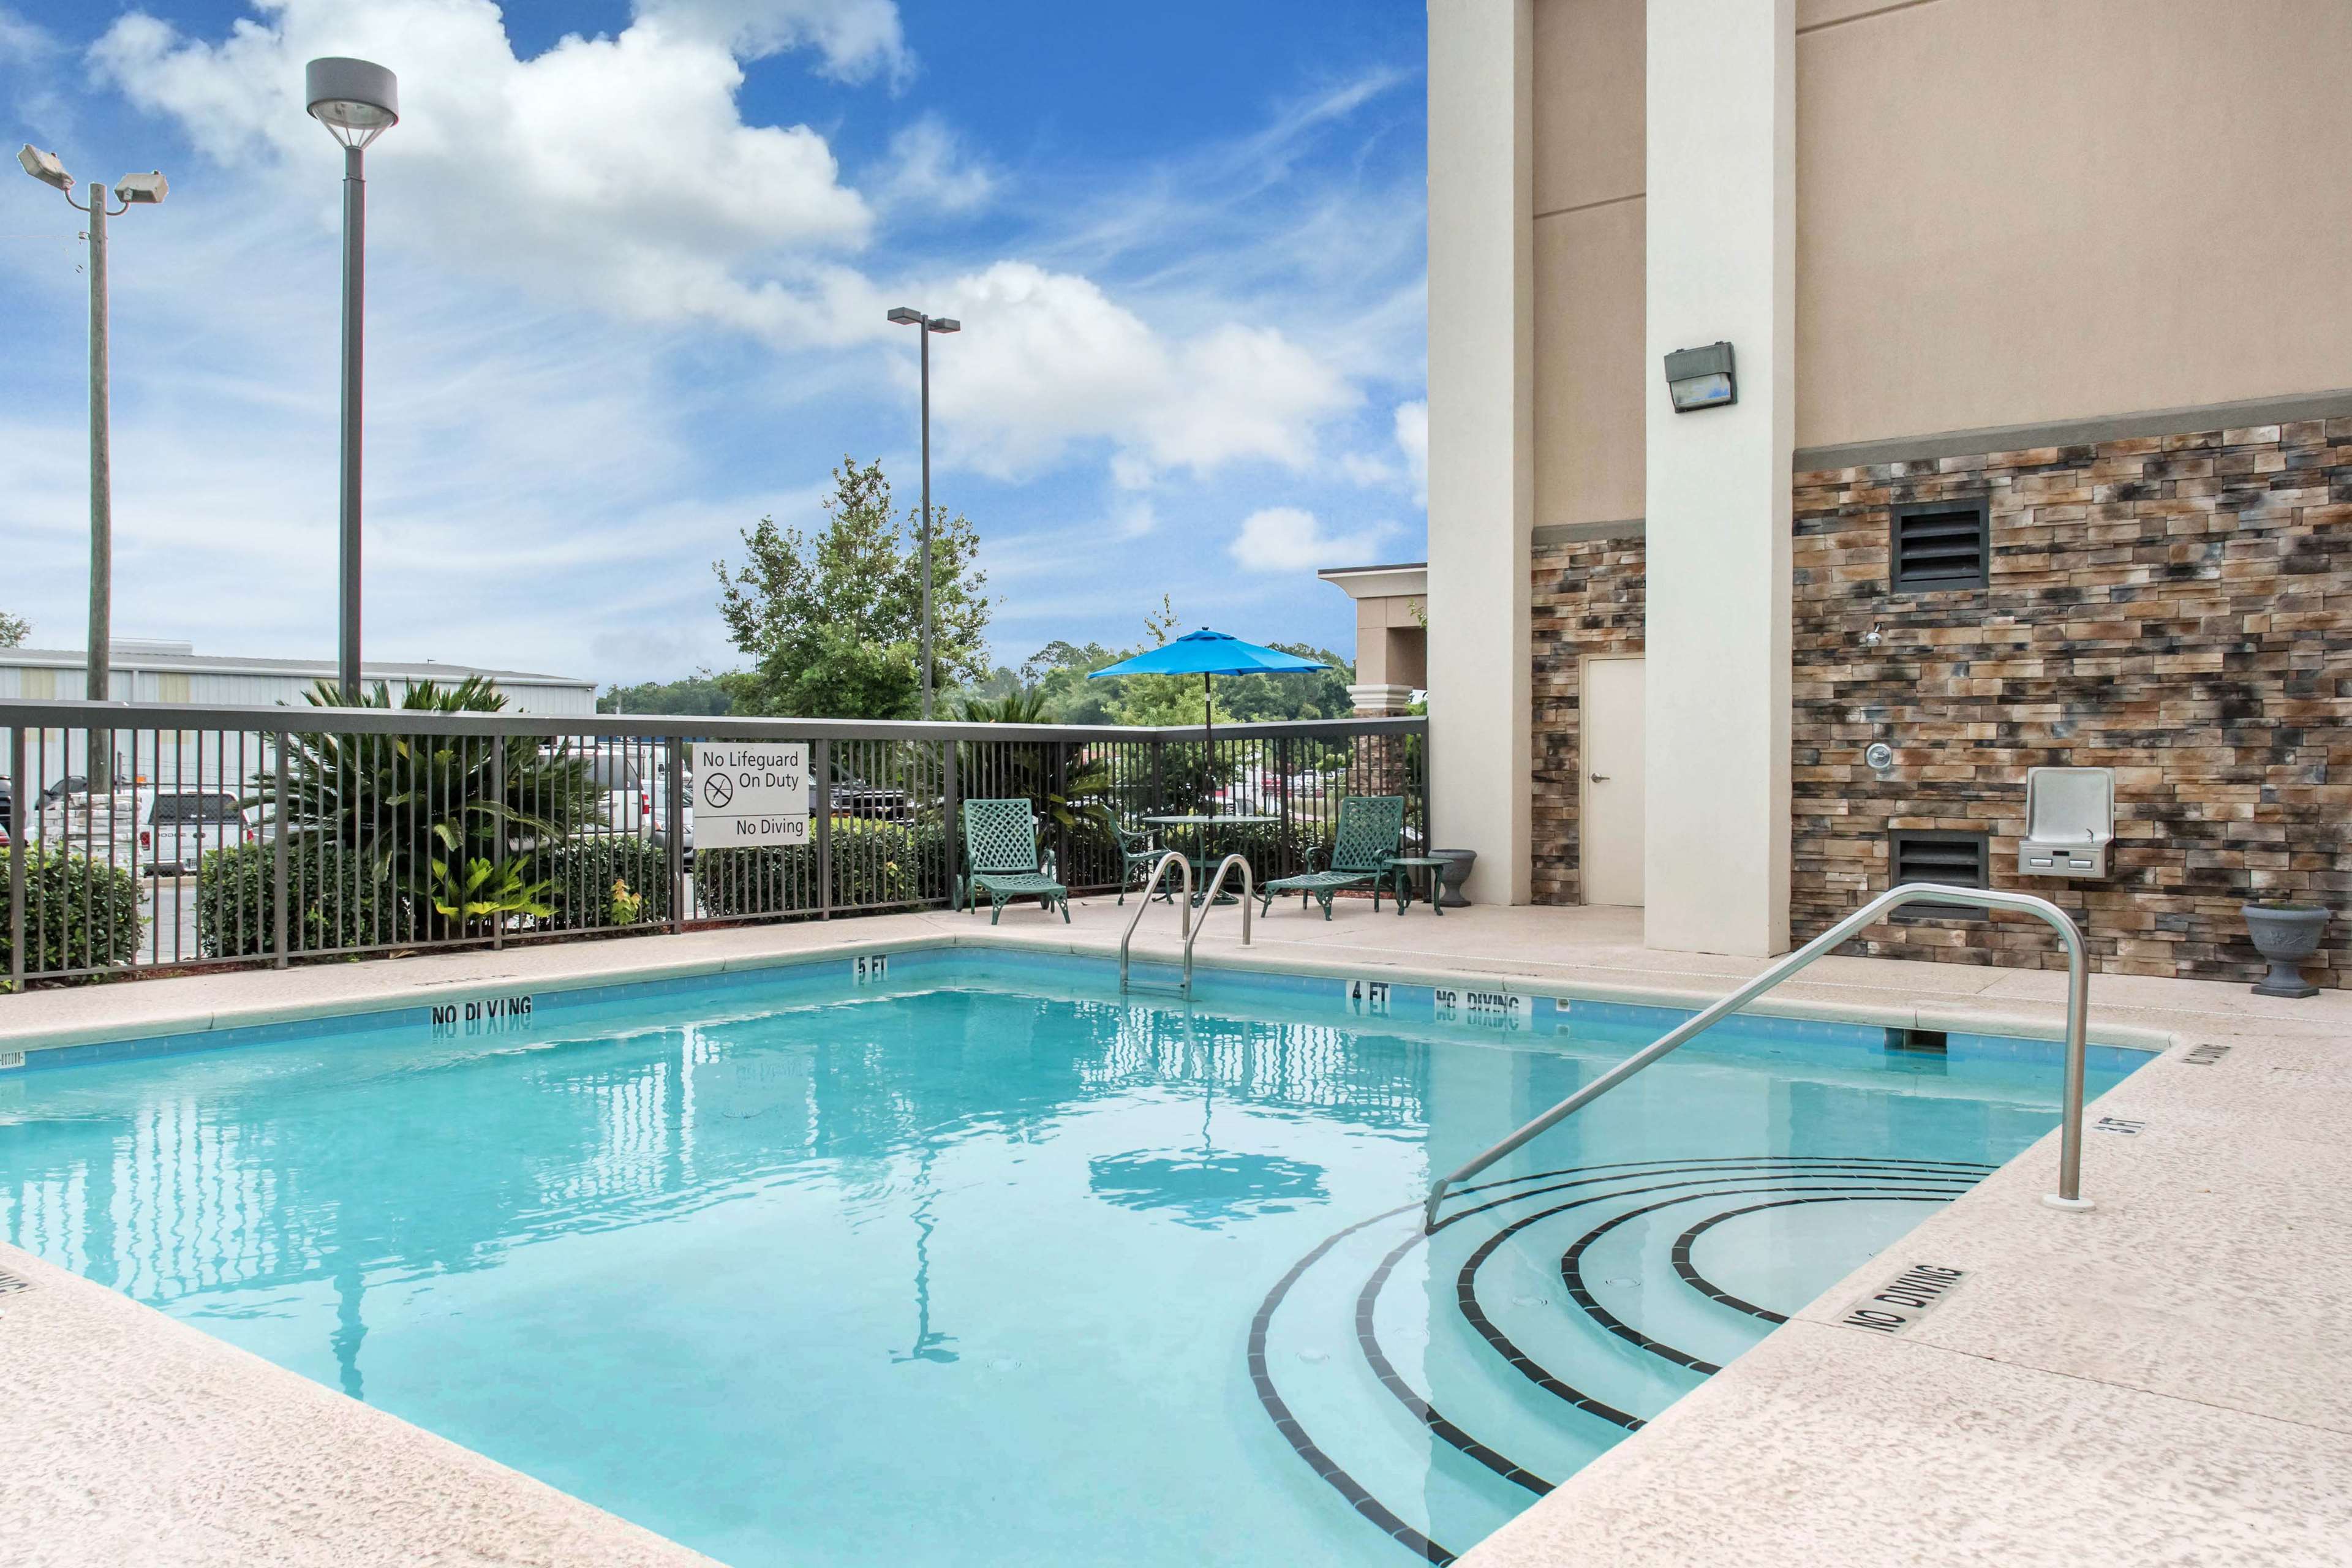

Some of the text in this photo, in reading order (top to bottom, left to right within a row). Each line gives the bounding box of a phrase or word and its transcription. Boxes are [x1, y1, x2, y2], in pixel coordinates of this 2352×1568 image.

[704, 751, 798, 771] No Lifeguard
[739, 773, 799, 791] On Duty
[737, 818, 803, 837] No Diving
[859, 954, 886, 973] 5 FT
[1352, 981, 1389, 1001] 4 FT
[432, 1005, 457, 1024] NO
[1842, 1265, 1964, 1332] NO DIVING
